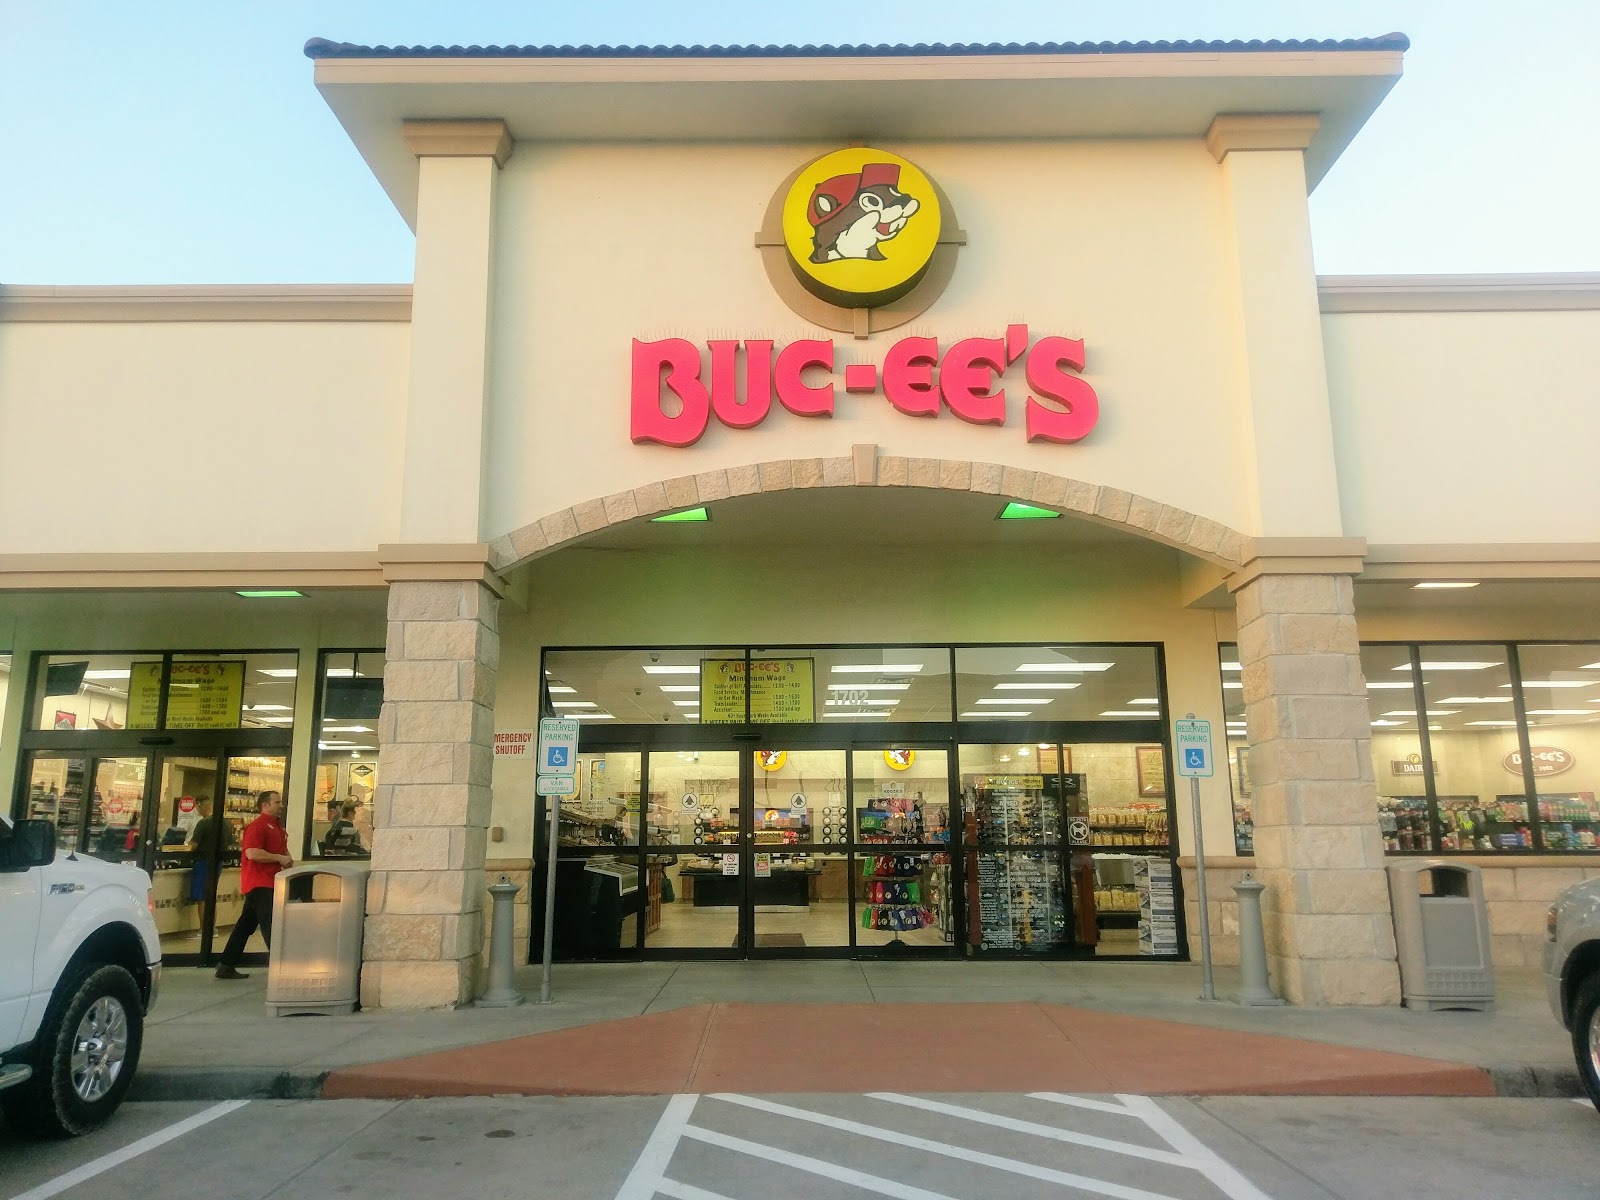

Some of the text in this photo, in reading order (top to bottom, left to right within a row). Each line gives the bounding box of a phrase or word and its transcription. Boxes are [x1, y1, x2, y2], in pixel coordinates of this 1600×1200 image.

[630, 323, 1100, 448] BUC-EE'S
[170, 664, 210, 676] UC-EE'S
[831, 689, 869, 705] 1702
[543, 723, 576, 732] RESERVED
[1177, 724, 1209, 733] RESERVED
[494, 732, 532, 742] MERGENCY
[544, 733, 574, 741] PARKING
[1180, 734, 1208, 742] PARKING
[495, 744, 526, 755] SHUTOFF
[1511, 751, 1565, 765] BC-EE'S
[1403, 764, 1424, 772] DAIR
